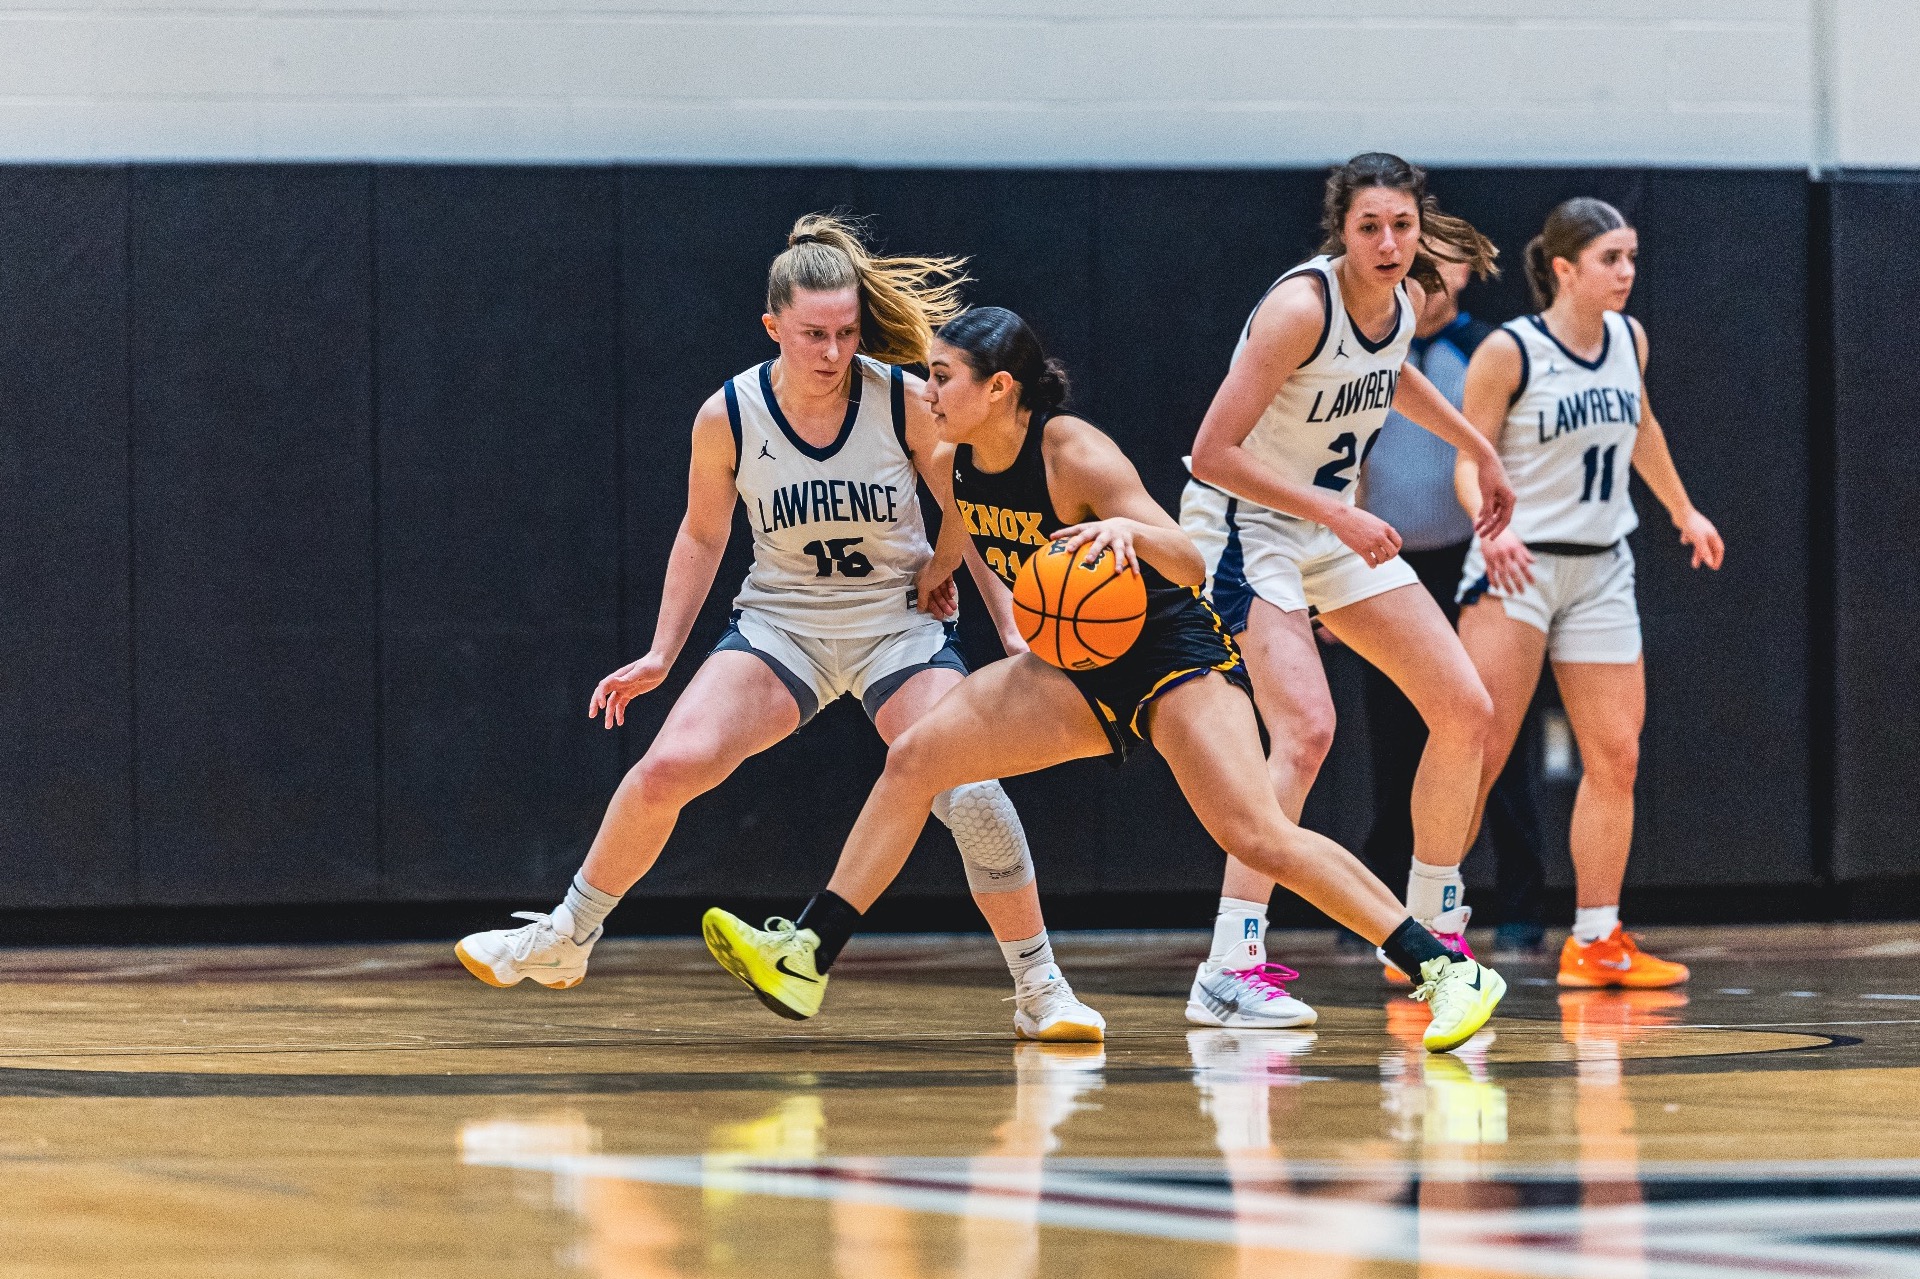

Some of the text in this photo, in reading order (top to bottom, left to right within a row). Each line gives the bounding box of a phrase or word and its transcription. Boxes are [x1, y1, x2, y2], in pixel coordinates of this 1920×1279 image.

[1305, 369, 1401, 423] LAWREN
[1579, 444, 1618, 503] 11
[757, 479, 898, 534] LAWRENCE
[956, 498, 1051, 546] KNOX
[802, 536, 875, 578] 15
